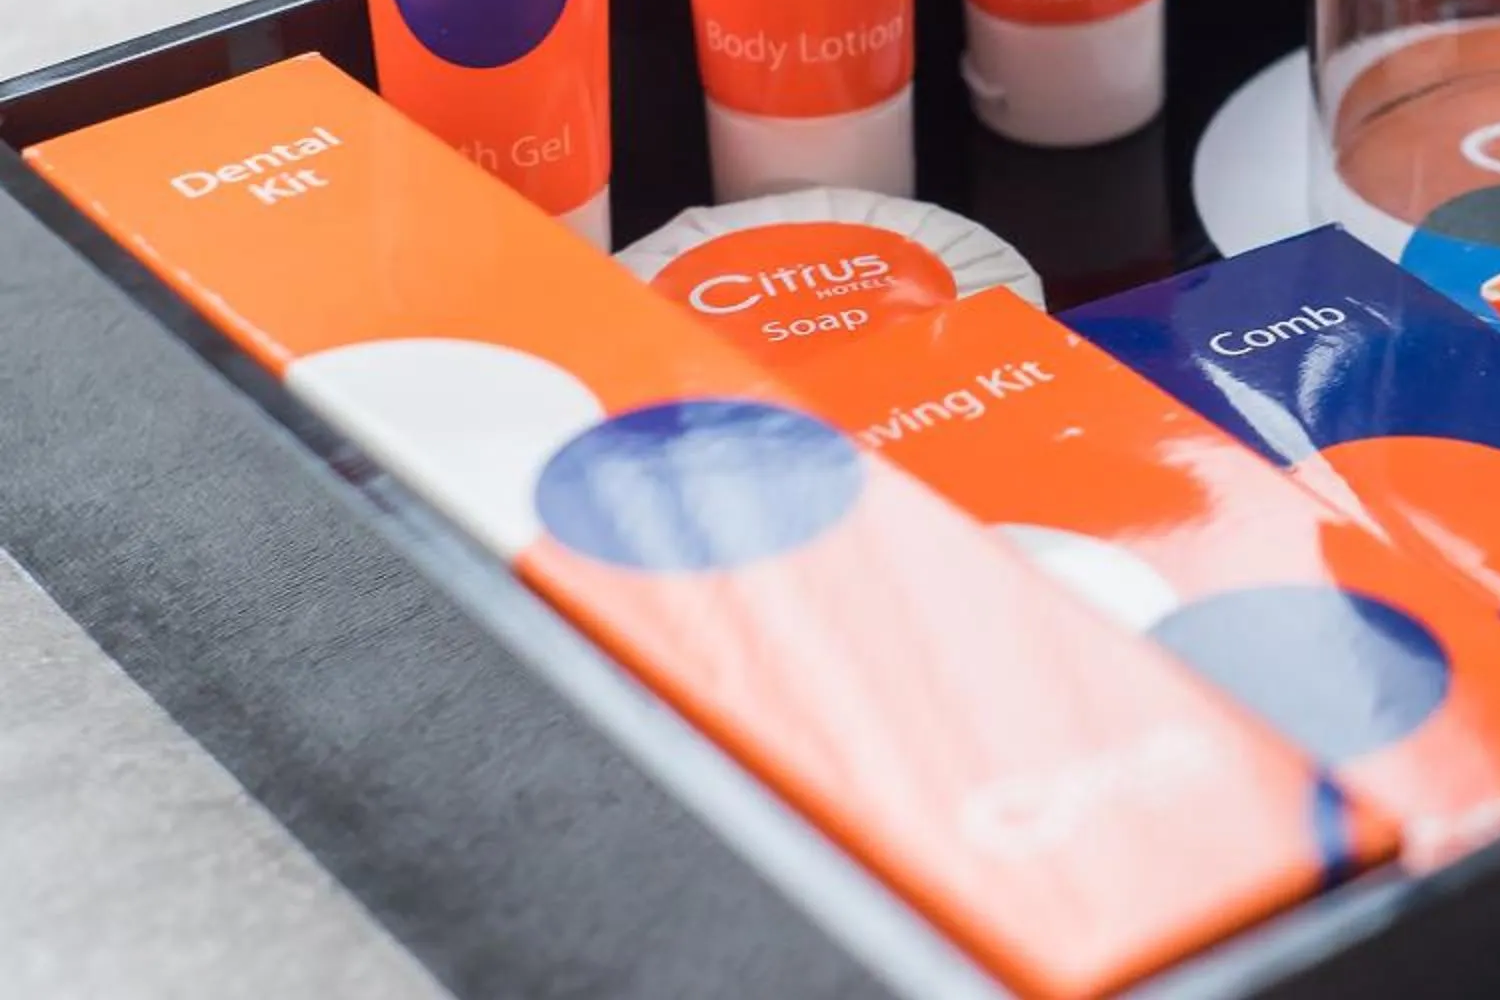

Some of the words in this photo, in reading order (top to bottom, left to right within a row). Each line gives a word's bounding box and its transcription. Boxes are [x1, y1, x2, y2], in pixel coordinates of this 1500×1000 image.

[706, 18, 788, 72] Body
[801, 15, 904, 63] Lotion
[169, 126, 342, 199] Dental
[511, 122, 571, 167] Gel
[247, 168, 330, 206] Kit
[688, 253, 892, 315] Citrus
[815, 275, 897, 301] HOTELS
[760, 306, 869, 342] Soap
[1208, 304, 1347, 357] Comb
[858, 388, 987, 449] ving
[975, 359, 1056, 398] Kit
